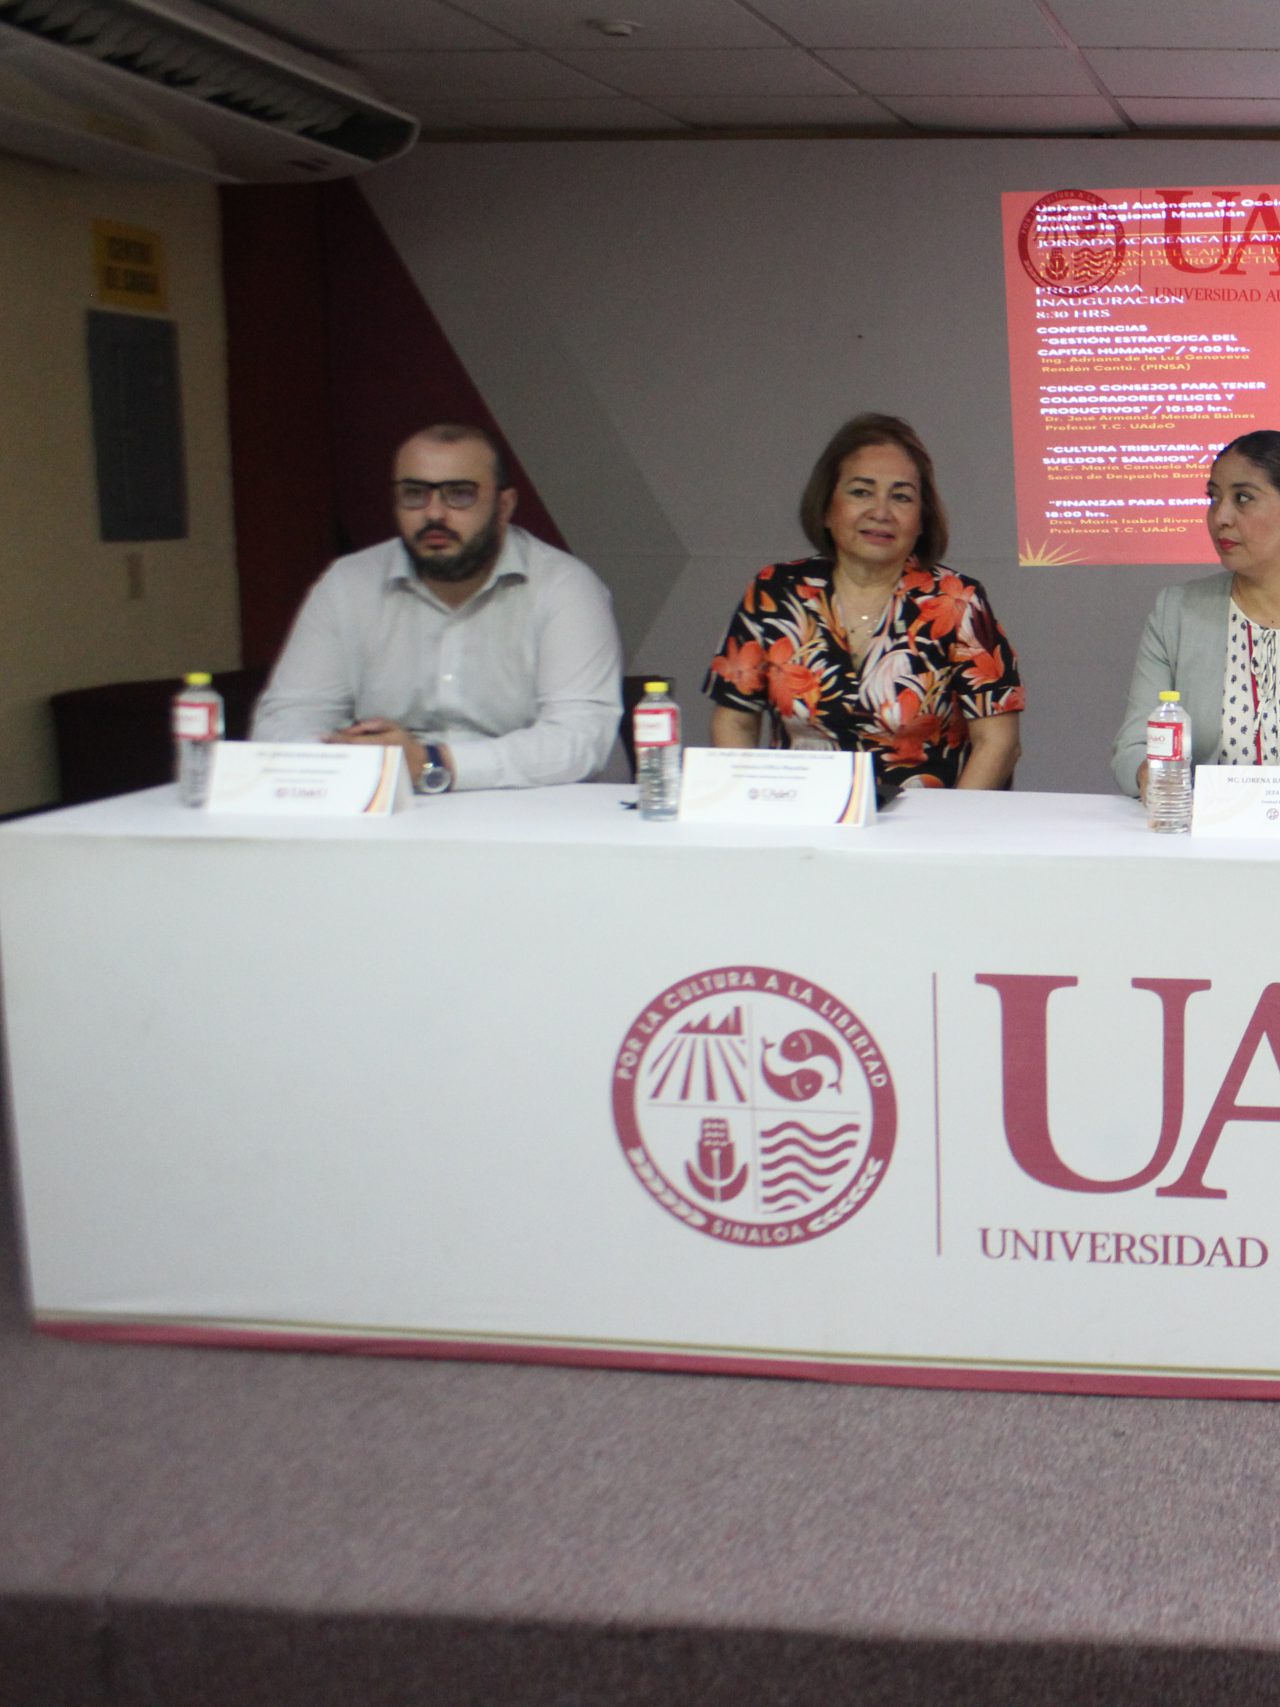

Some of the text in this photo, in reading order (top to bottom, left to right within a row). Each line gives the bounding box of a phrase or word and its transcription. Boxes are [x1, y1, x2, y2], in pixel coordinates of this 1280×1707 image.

[1036, 202, 1128, 213] Universidad
[1216, 199, 1236, 208] de
[1036, 213, 1092, 223] Unidad
[1097, 210, 1167, 223] Regional
[1037, 238, 1116, 248] JORNADA
[1035, 284, 1144, 296] PROGRAMA
[1155, 287, 1262, 302] UNIVERSIDAD
[1036, 294, 1185, 307] INAUGURACIÓN
[1036, 308, 1111, 319] 8:30 HRS
[1036, 324, 1148, 334] CONFERENCIAS
[1212, 333, 1239, 342] DEL
[1037, 347, 1095, 356] CAPITAL
[1070, 355, 1121, 363] Adriana
[1124, 354, 1141, 362] de
[1184, 353, 1250, 361] Genoveva
[1140, 362, 1192, 373] (PINSA)
[1099, 382, 1178, 392] CONSEJOS
[1180, 382, 1219, 391] PARA
[1221, 381, 1267, 390] TENER
[1039, 392, 1236, 404] COLABORADORES FELICES Y
[1099, 413, 1158, 422] Armando
[1213, 412, 1256, 420] Bulnes
[1045, 424, 1098, 432] Profesor
[1129, 421, 1176, 430] UAdeO
[1042, 457, 1106, 465] SUELDOS
[1108, 456, 1118, 464] Y
[1123, 462, 1182, 470] Consuelo
[1106, 472, 1169, 481] Despacho
[1128, 498, 1166, 507] PARA
[1121, 516, 1159, 525] Isabel
[1162, 516, 1203, 525] Rivera
[1050, 527, 1110, 535] Profesora
[1142, 525, 1187, 533] UAdeO
[663, 971, 756, 1010] CULTURA
[763, 974, 779, 991] A
[788, 980, 813, 1003] LA
[820, 999, 888, 1088] LIBERTAD
[711, 1220, 805, 1245] SINALOA
[978, 1226, 1269, 1268] UNIVERSIDAD
